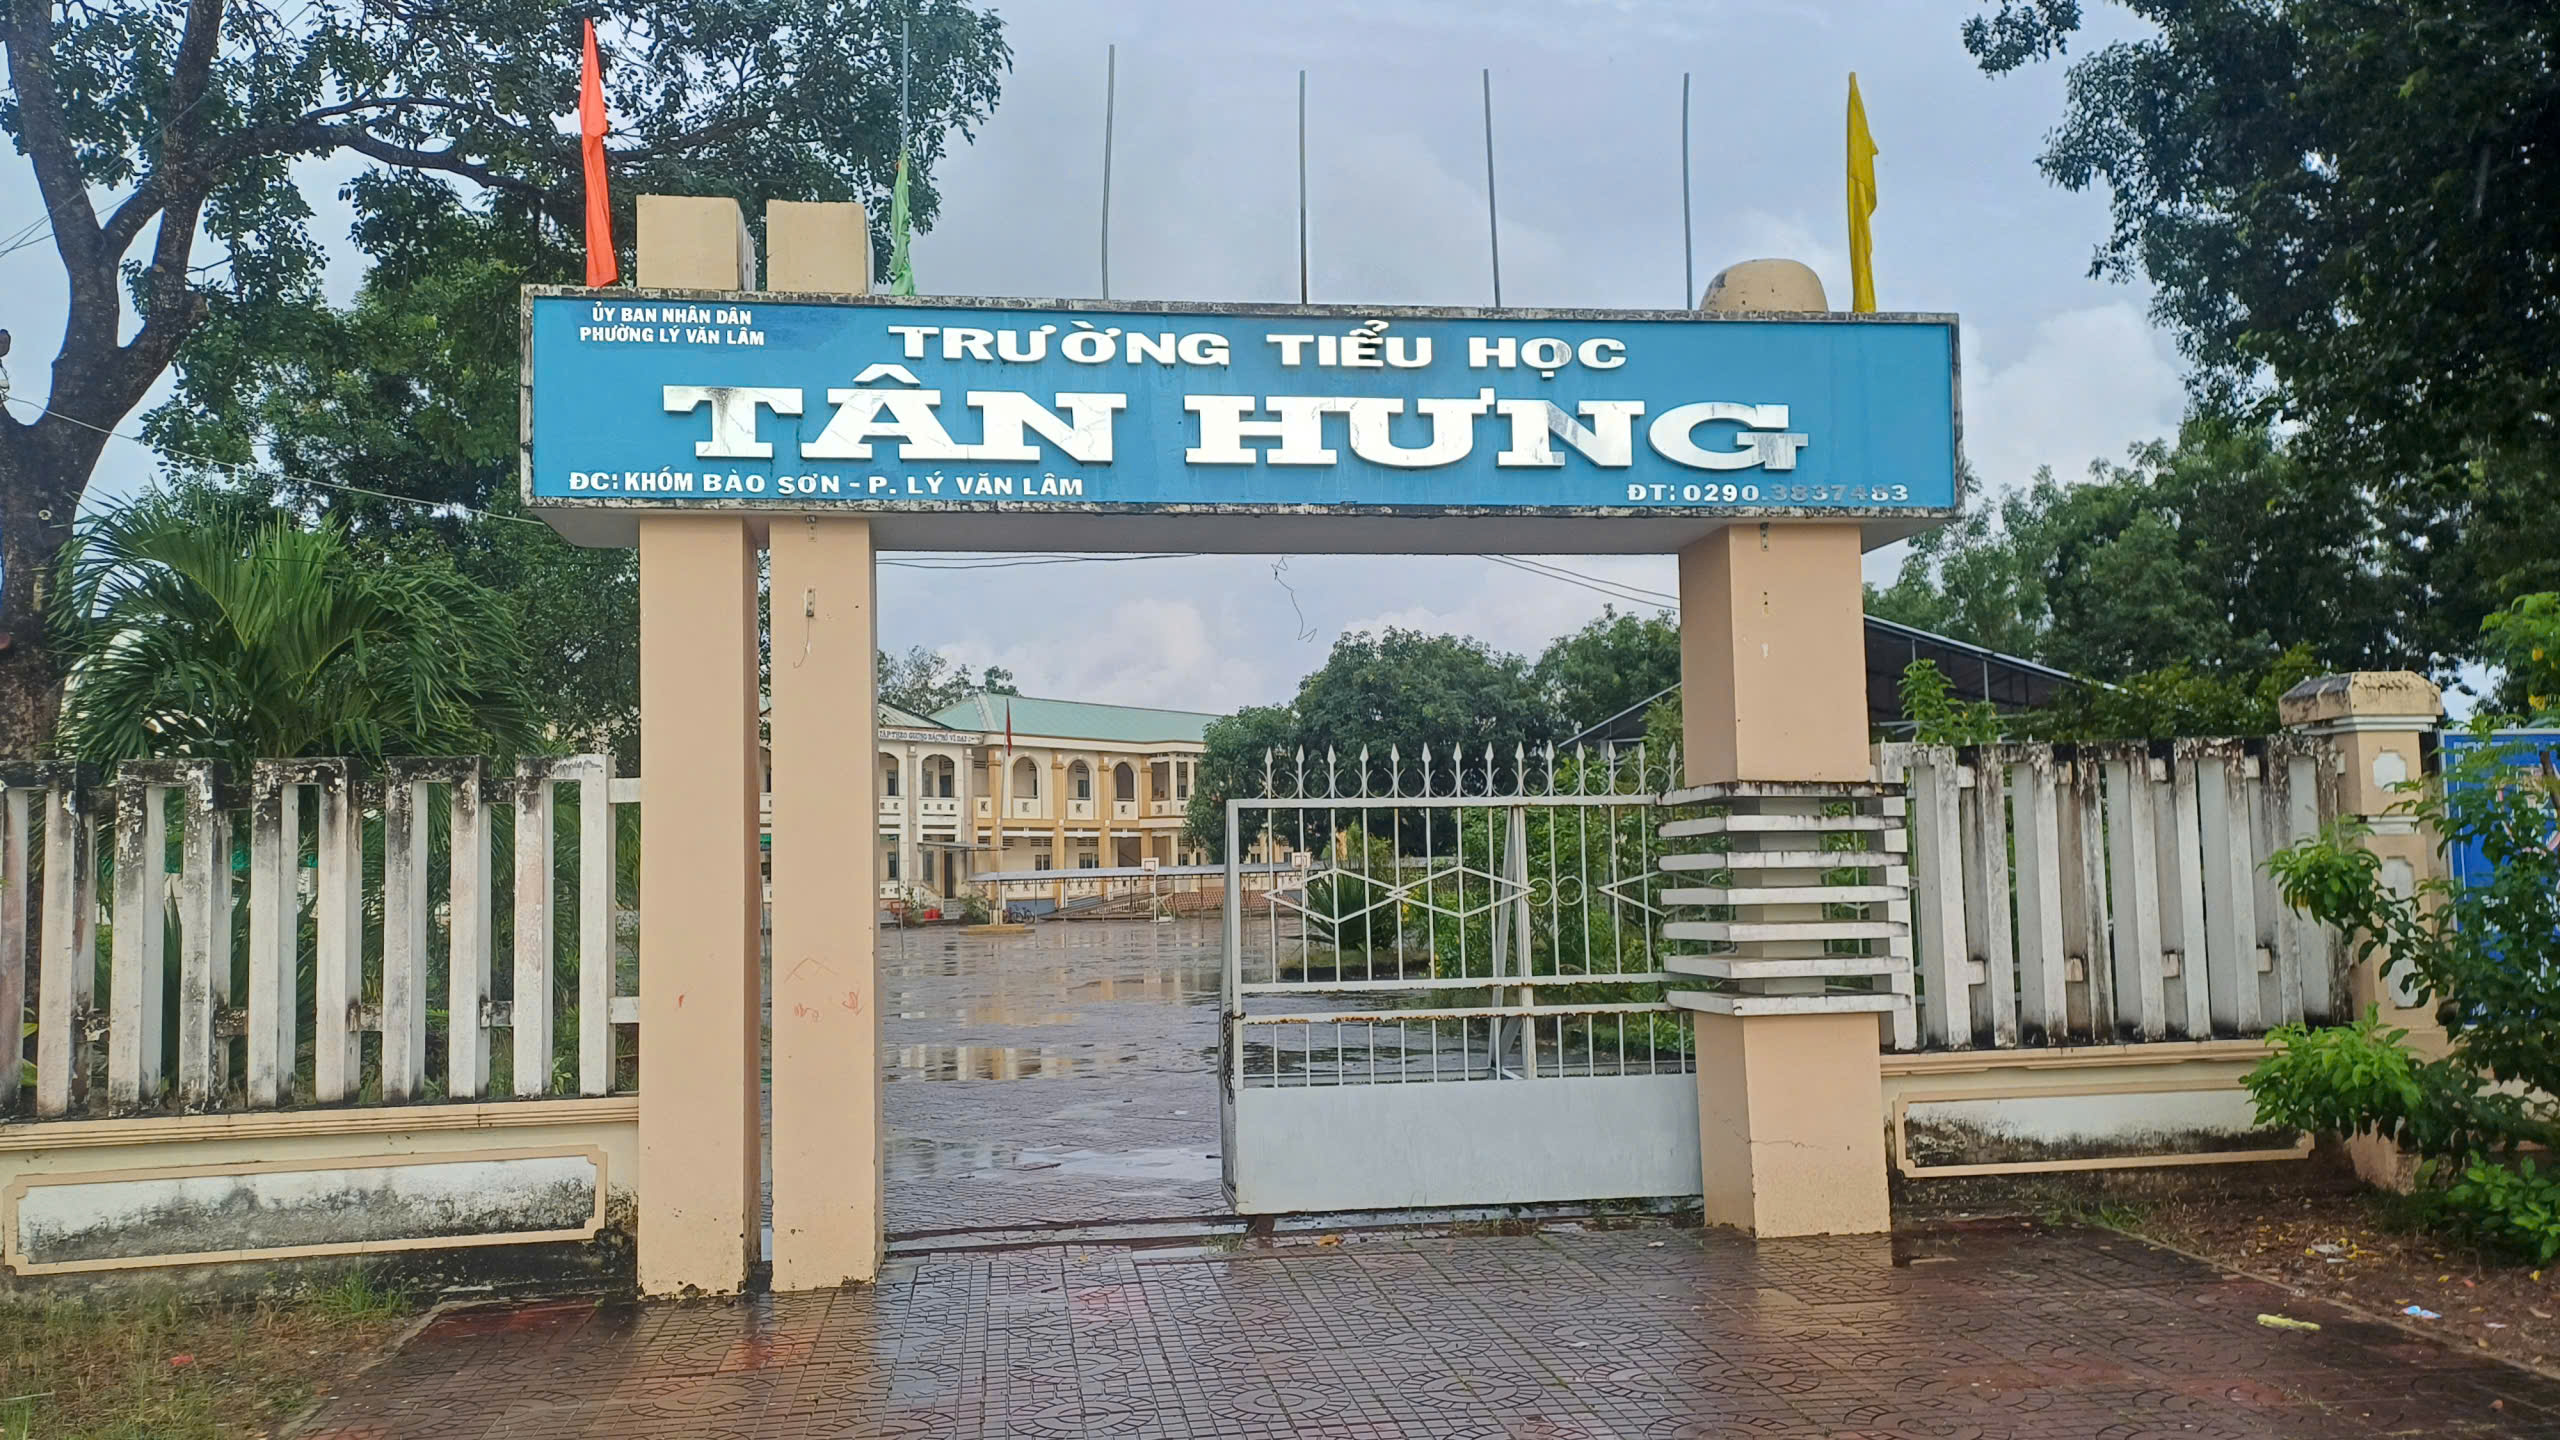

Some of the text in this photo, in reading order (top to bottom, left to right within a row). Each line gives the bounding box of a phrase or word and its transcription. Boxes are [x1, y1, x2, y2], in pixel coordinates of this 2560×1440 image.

[592, 301, 752, 325] ỦY BAN NHÂN DÂN
[579, 323, 765, 346] PHƯỜNG LÝ VĂN LÂM
[887, 319, 1628, 378] TRƯỜNG TIỂU HỌC
[662, 363, 1809, 471] TÂN HƯNG
[703, 469, 766, 493] BÀO
[777, 473, 840, 495] SƠN
[868, 476, 897, 495] P.
[907, 470, 944, 495] LÝ
[955, 472, 1013, 496] VĂN
[1023, 472, 1083, 496] LÂM
